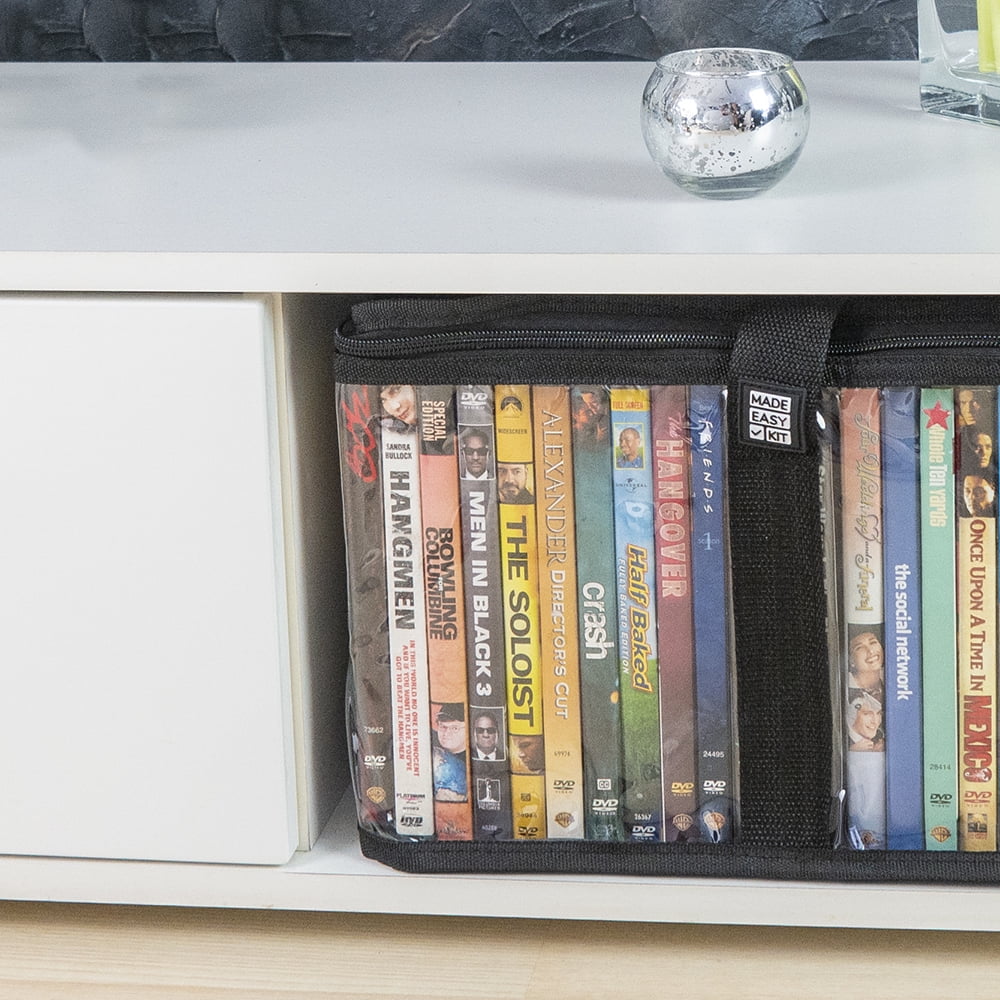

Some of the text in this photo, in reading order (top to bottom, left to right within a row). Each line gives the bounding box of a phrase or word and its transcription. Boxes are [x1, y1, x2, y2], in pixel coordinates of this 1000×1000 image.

[461, 392, 488, 401] DVD
[751, 393, 788, 411] MADE
[421, 400, 433, 441] EDITION
[434, 400, 446, 441] SPECIAL
[752, 411, 787, 427] EASY
[768, 431, 788, 443] KIT
[929, 463, 949, 487] Ten
[656, 439, 689, 599] HANGOVER
[389, 470, 416, 631] HANGMEN
[540, 409, 571, 720] ALEXANDER DIRECTOR'S CUT
[425, 527, 442, 640] COLUMBINE
[439, 527, 458, 640] BOWLING
[469, 491, 493, 697] MEN IN BLACK 3
[506, 514, 535, 728] THE SOLOIST
[582, 582, 615, 660] crash
[618, 558, 630, 675] FULLY BAKED EDITION
[626, 544, 654, 692] Half Baked
[894, 563, 913, 701] the social network
[963, 519, 993, 784] ONCE UPON A TIME IN MEXICO
[592, 799, 619, 807] DVD
[671, 782, 694, 790] DVD
[703, 780, 727, 788] DVD
[930, 793, 953, 801] DVD
[964, 790, 993, 799] DVD
[632, 825, 656, 833] DVD
